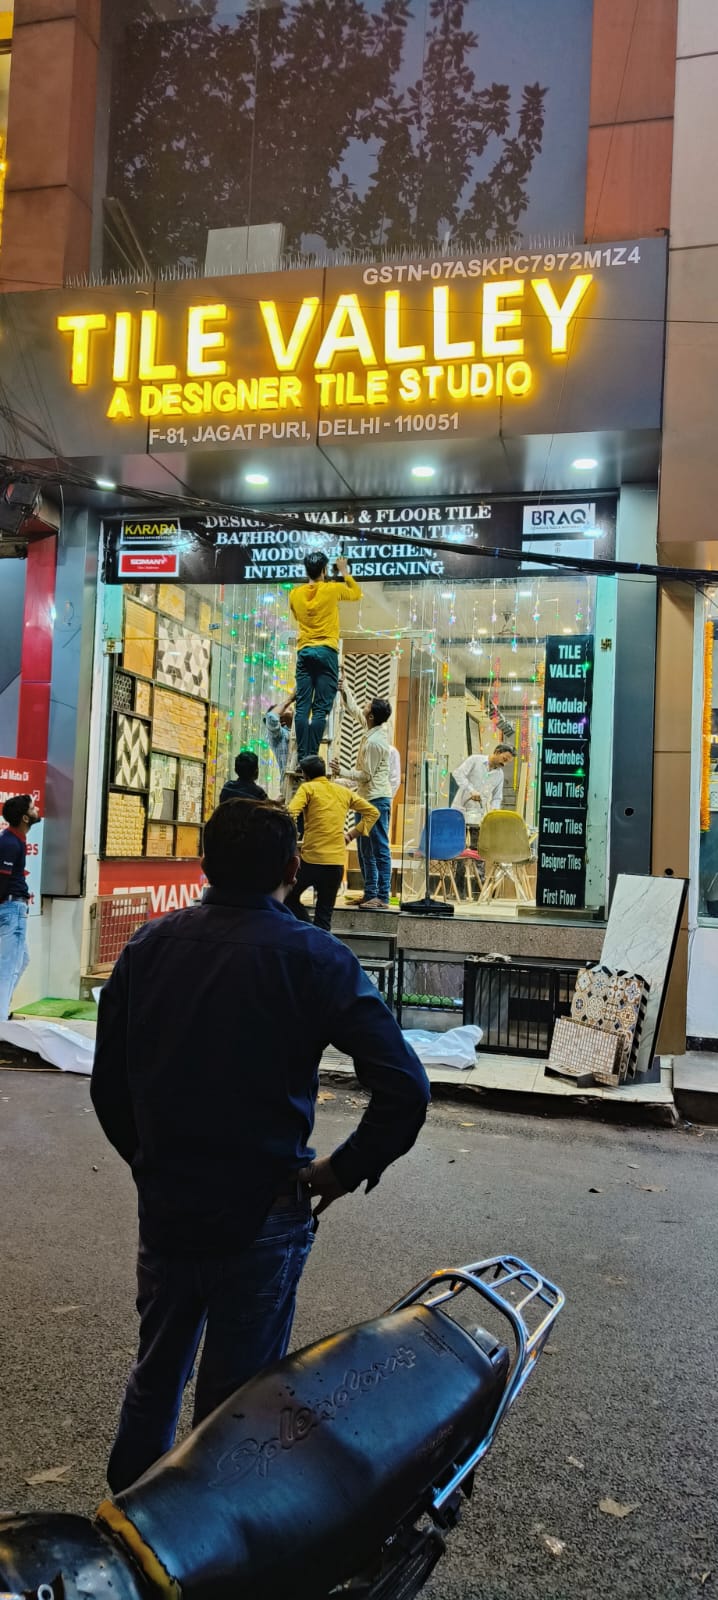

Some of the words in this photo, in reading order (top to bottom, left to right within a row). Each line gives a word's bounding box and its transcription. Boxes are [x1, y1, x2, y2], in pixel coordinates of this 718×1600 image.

[363, 246, 641, 285] GSTN-07ASKPC7972M1Z4
[57, 303, 228, 386] TILE
[259, 274, 594, 372] VALLEY
[106, 387, 133, 419] A
[139, 375, 304, 418] DESIGNER
[314, 370, 389, 407] TILE
[398, 360, 533, 403] STUDIO
[149, 427, 188, 446] F-81,
[359, 509, 371, 523] &
[375, 507, 442, 523] FLOOR
[445, 505, 492, 520] TILE
[531, 508, 586, 525] BRAQ
[428, 523, 479, 539] TILE,
[346, 544, 437, 559] KITCHEN,
[244, 564, 335, 579] INTERIR
[558, 645, 581, 659] TILE
[549, 664, 588, 679] VALLEY
[547, 698, 587, 713] Modular
[547, 718, 584, 735] Kitchen
[545, 748, 584, 766] Wardrobes
[545, 781, 563, 798] Wall
[565, 782, 585, 799] Tiles
[542, 817, 562, 833] Floor
[565, 818, 583, 834] Tiles
[541, 853, 567, 872] Designer
[567, 854, 582, 870] Tiles
[542, 889, 558, 904] First
[559, 890, 576, 906] Floor
